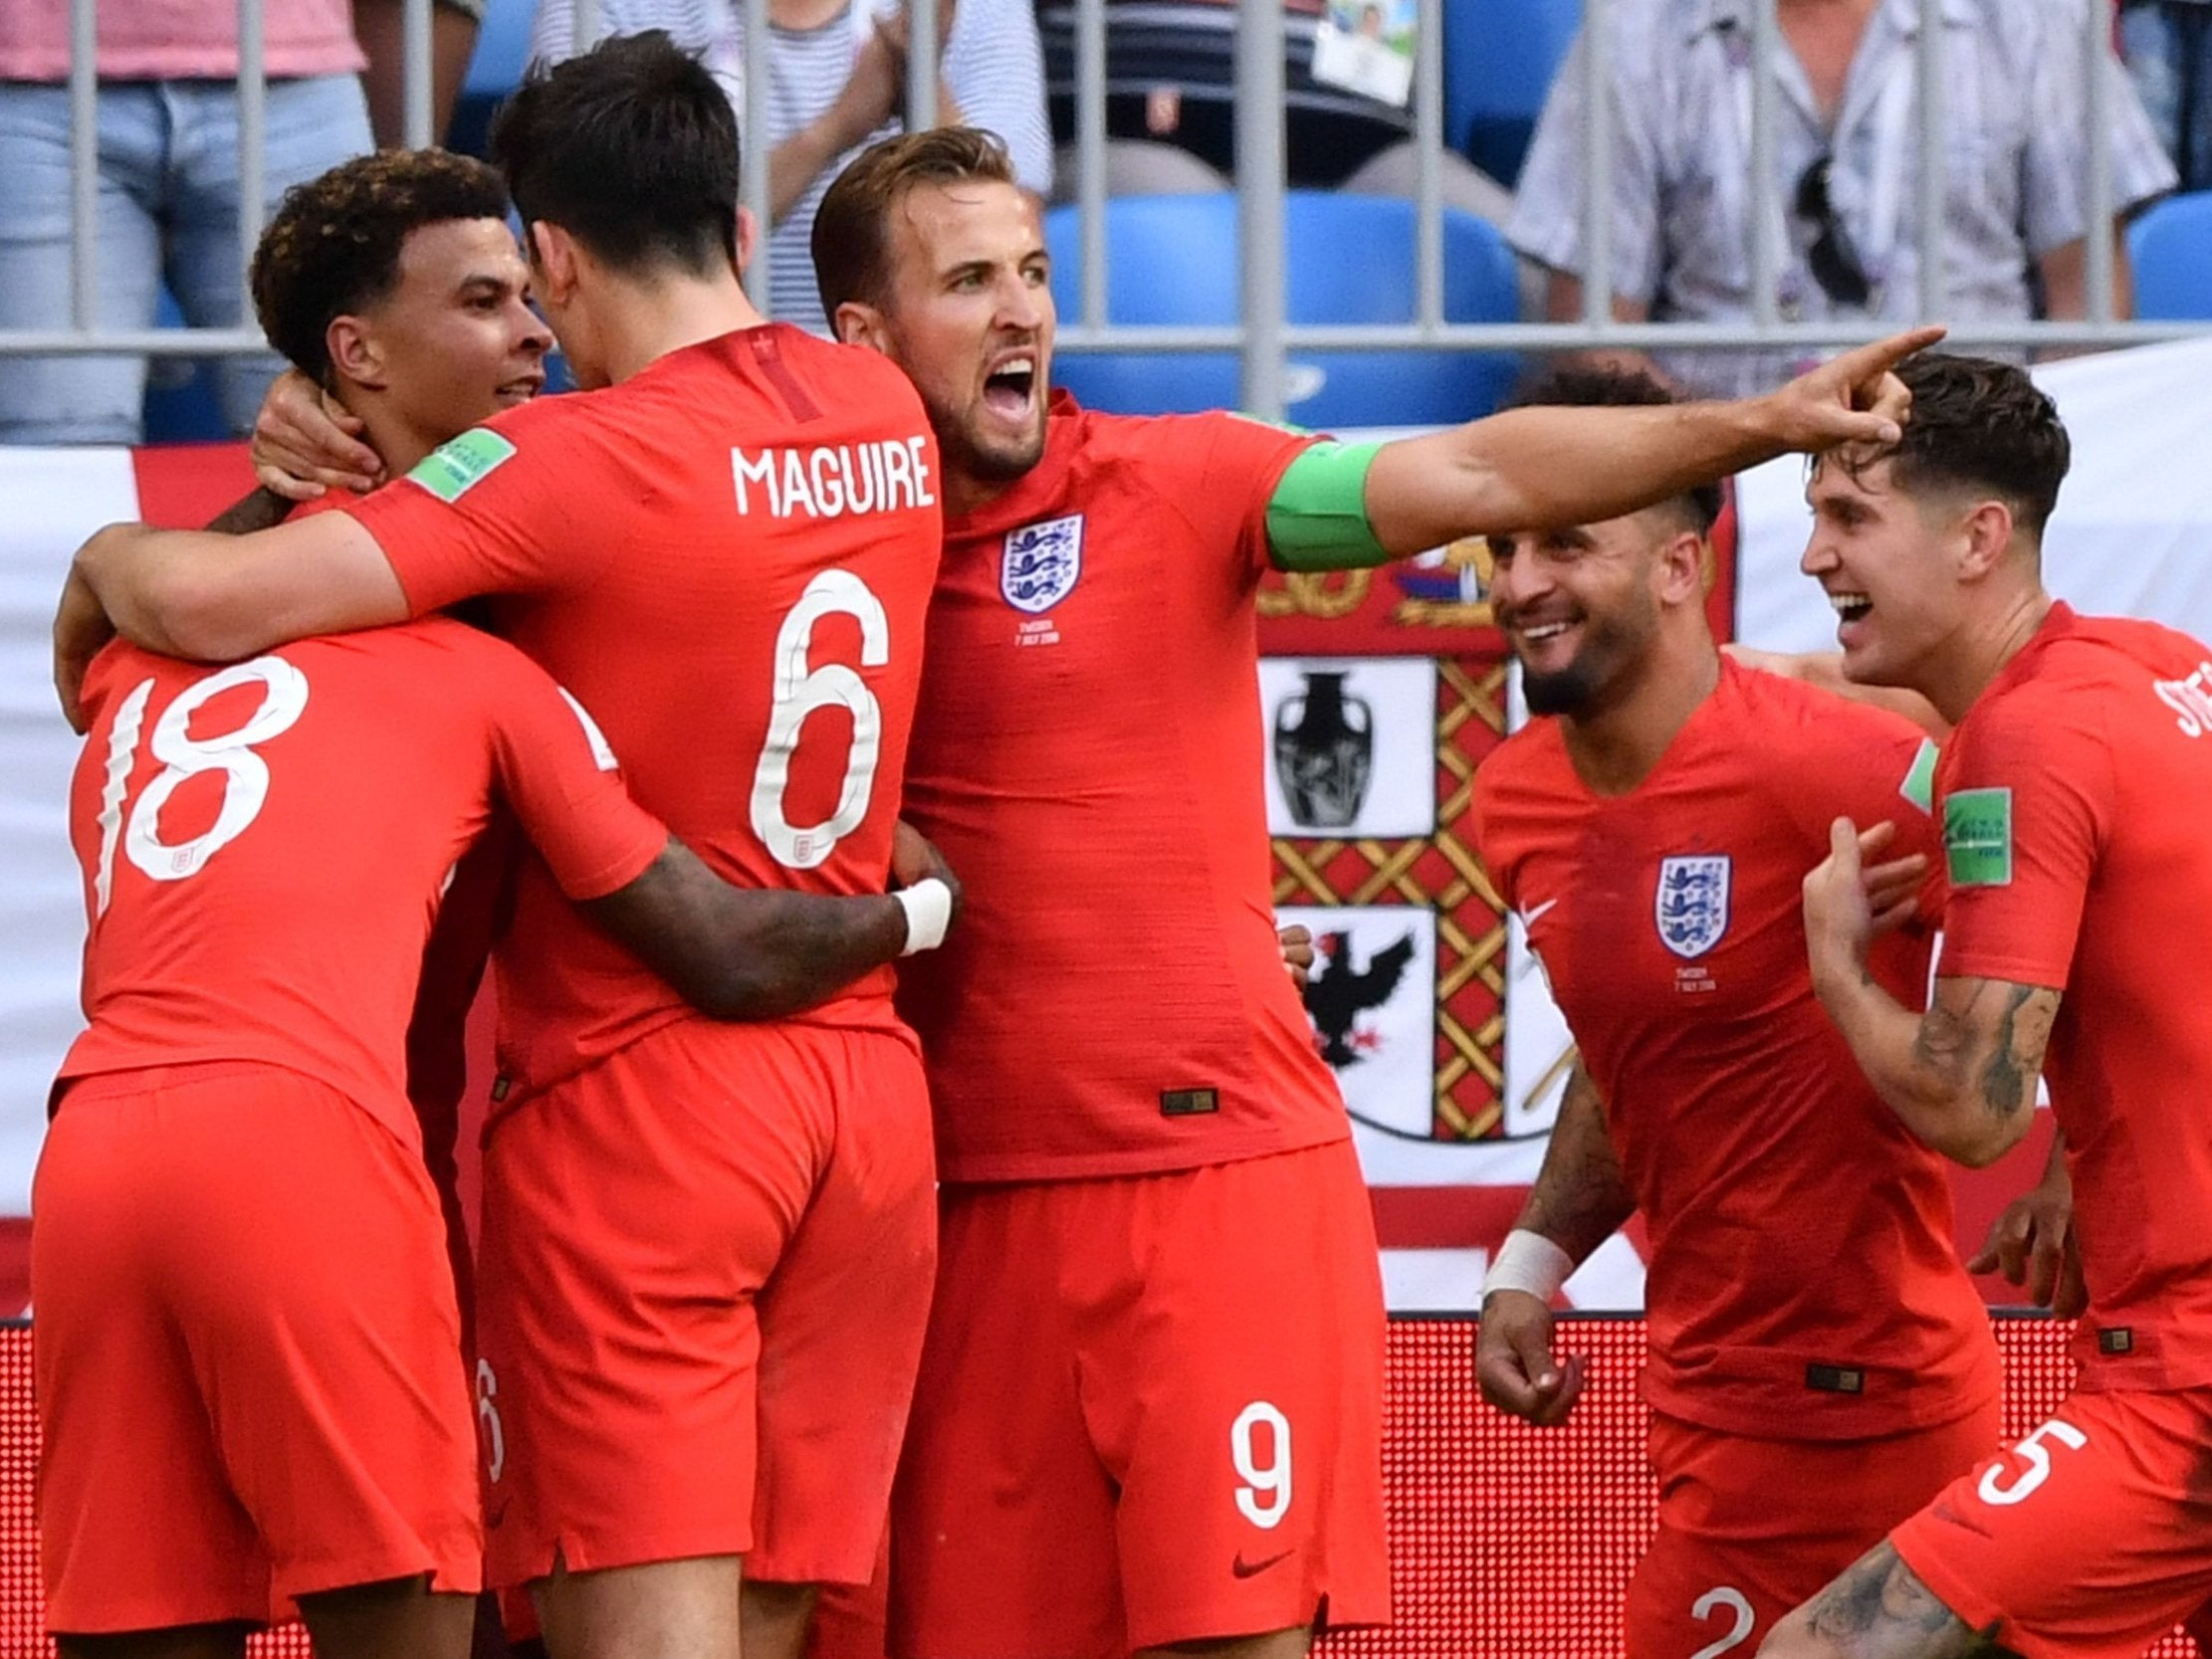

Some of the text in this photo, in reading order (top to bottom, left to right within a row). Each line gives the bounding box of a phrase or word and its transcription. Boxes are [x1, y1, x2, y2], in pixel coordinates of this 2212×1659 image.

[731, 435, 935, 518] MAGUIRE
[750, 568, 889, 869] 6
[95, 655, 310, 920] 18
[1230, 1400, 1293, 1529] 9
[1977, 1419, 2088, 1504] 5
[1690, 1585, 1755, 1659] 2
